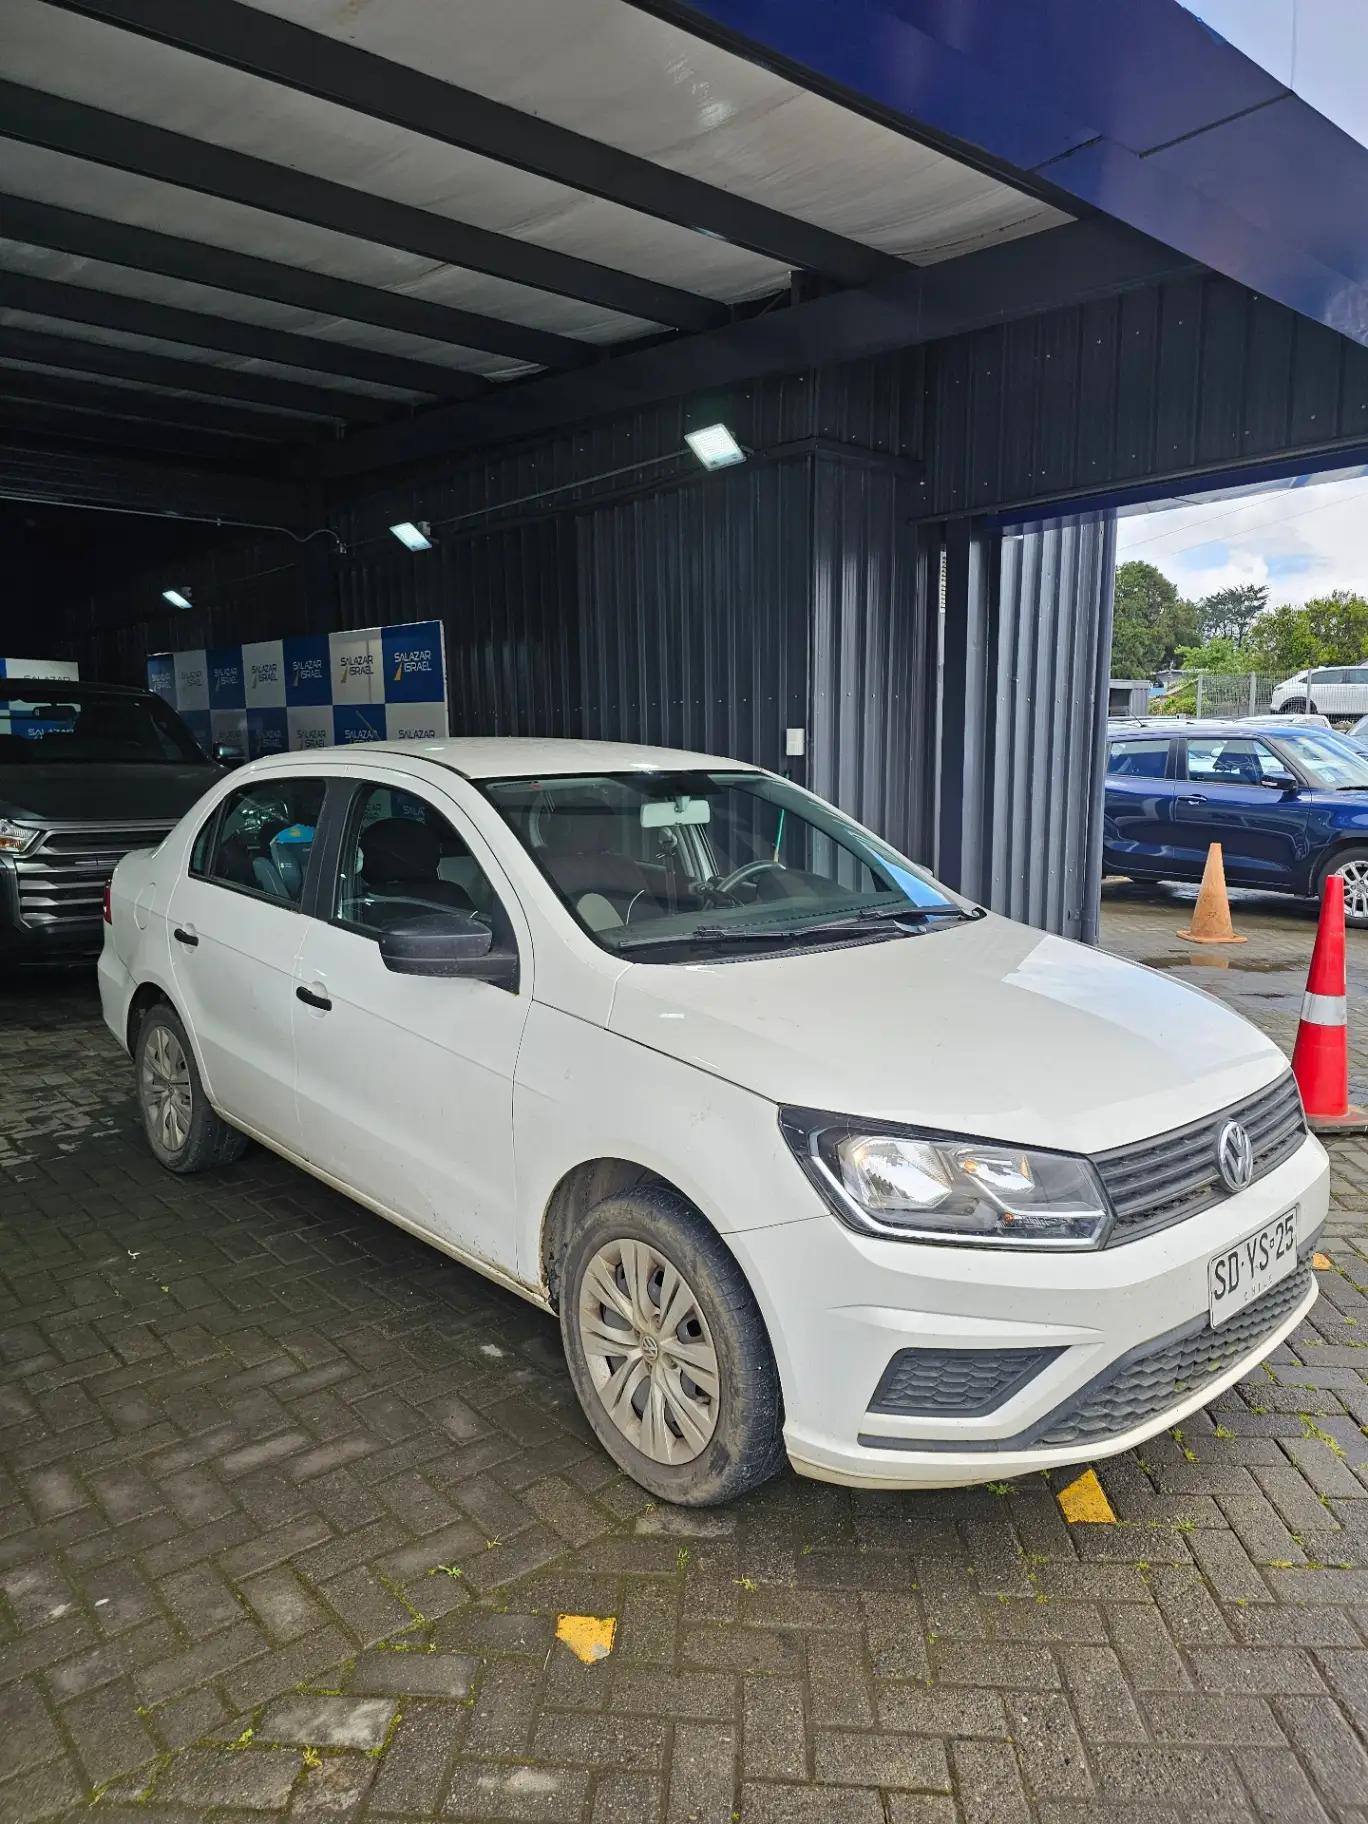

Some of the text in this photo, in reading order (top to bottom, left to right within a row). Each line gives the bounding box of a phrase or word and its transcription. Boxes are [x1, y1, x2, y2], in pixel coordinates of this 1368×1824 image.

[340, 655, 374, 666] SALAZAR
[394, 650, 432, 663] SALAZAR
[292, 659, 322, 670] SALAZAR
[404, 661, 432, 672] ISRAEL
[349, 665, 374, 676] ISRAEL
[398, 729, 436, 739] SALAZAR
